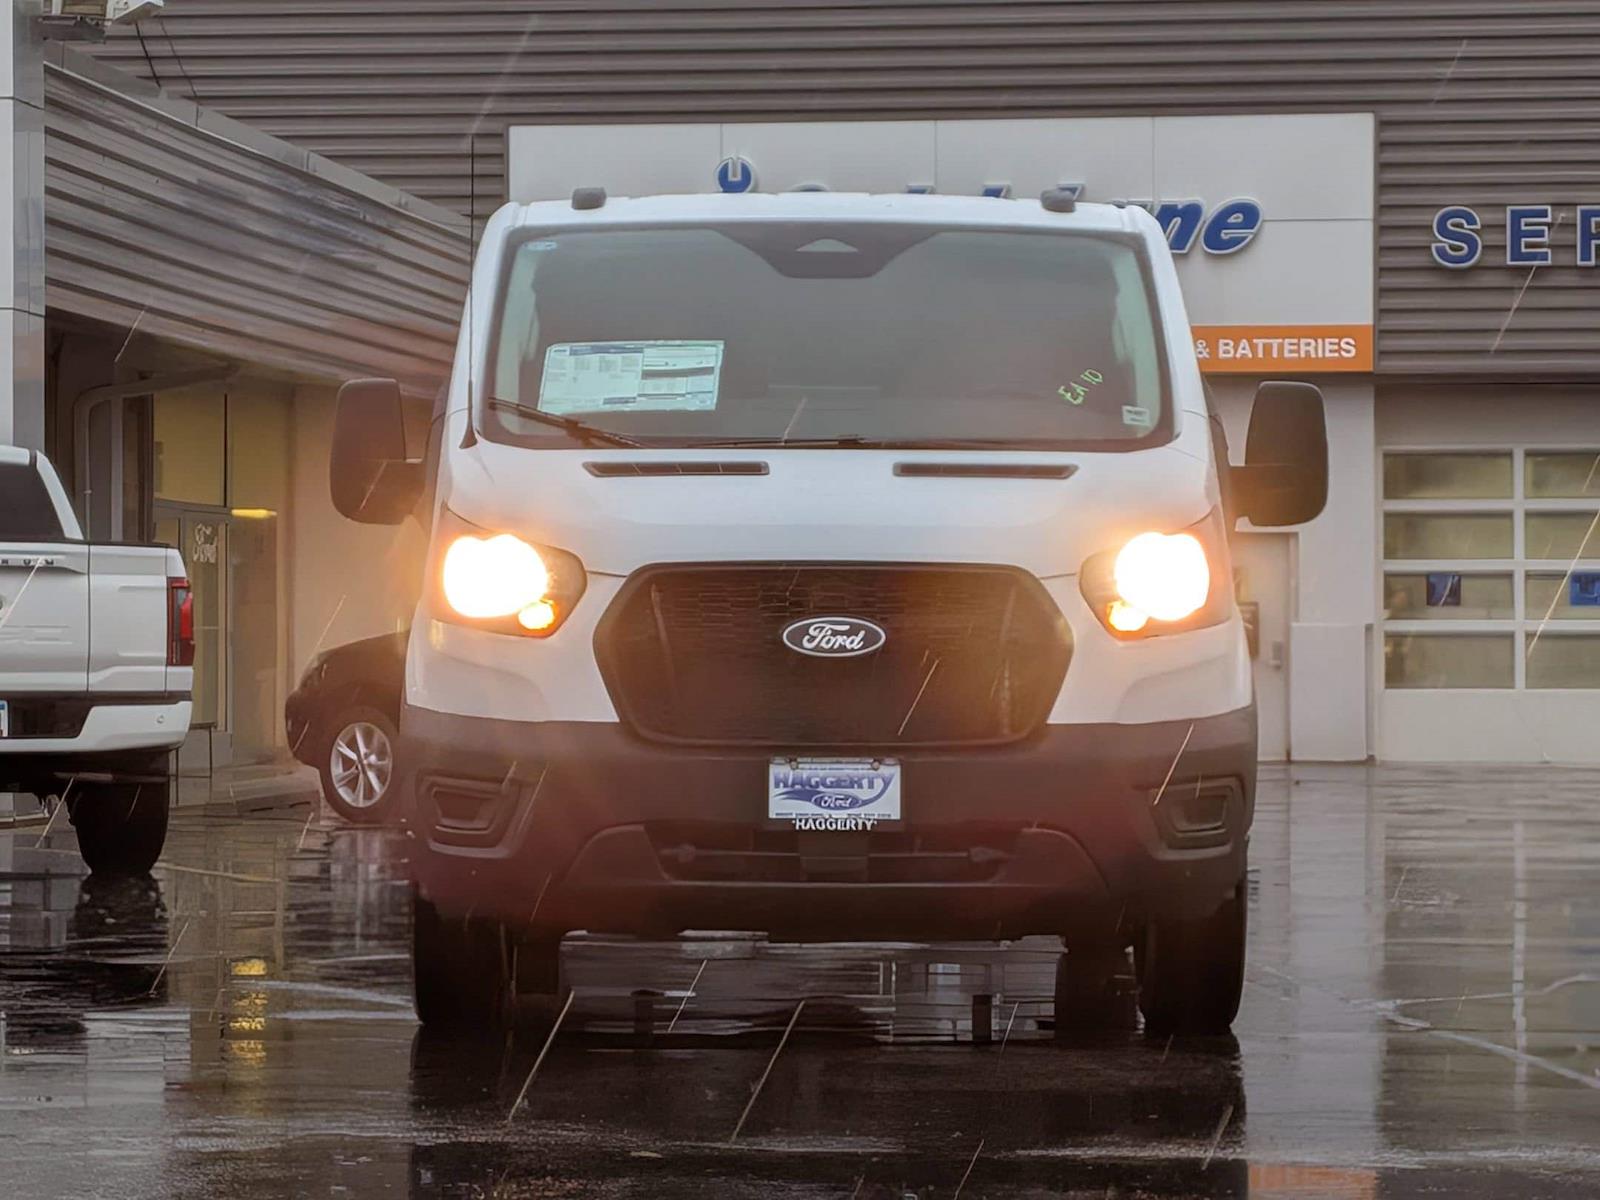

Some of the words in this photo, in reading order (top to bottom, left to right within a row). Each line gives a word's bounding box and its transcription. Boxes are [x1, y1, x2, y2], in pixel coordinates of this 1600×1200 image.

[1218, 338, 1356, 358] BATTERIES
[802, 623, 866, 649] Ford
[773, 770, 896, 789] HAGGERTY
[795, 818, 874, 830] HAGGERTY
